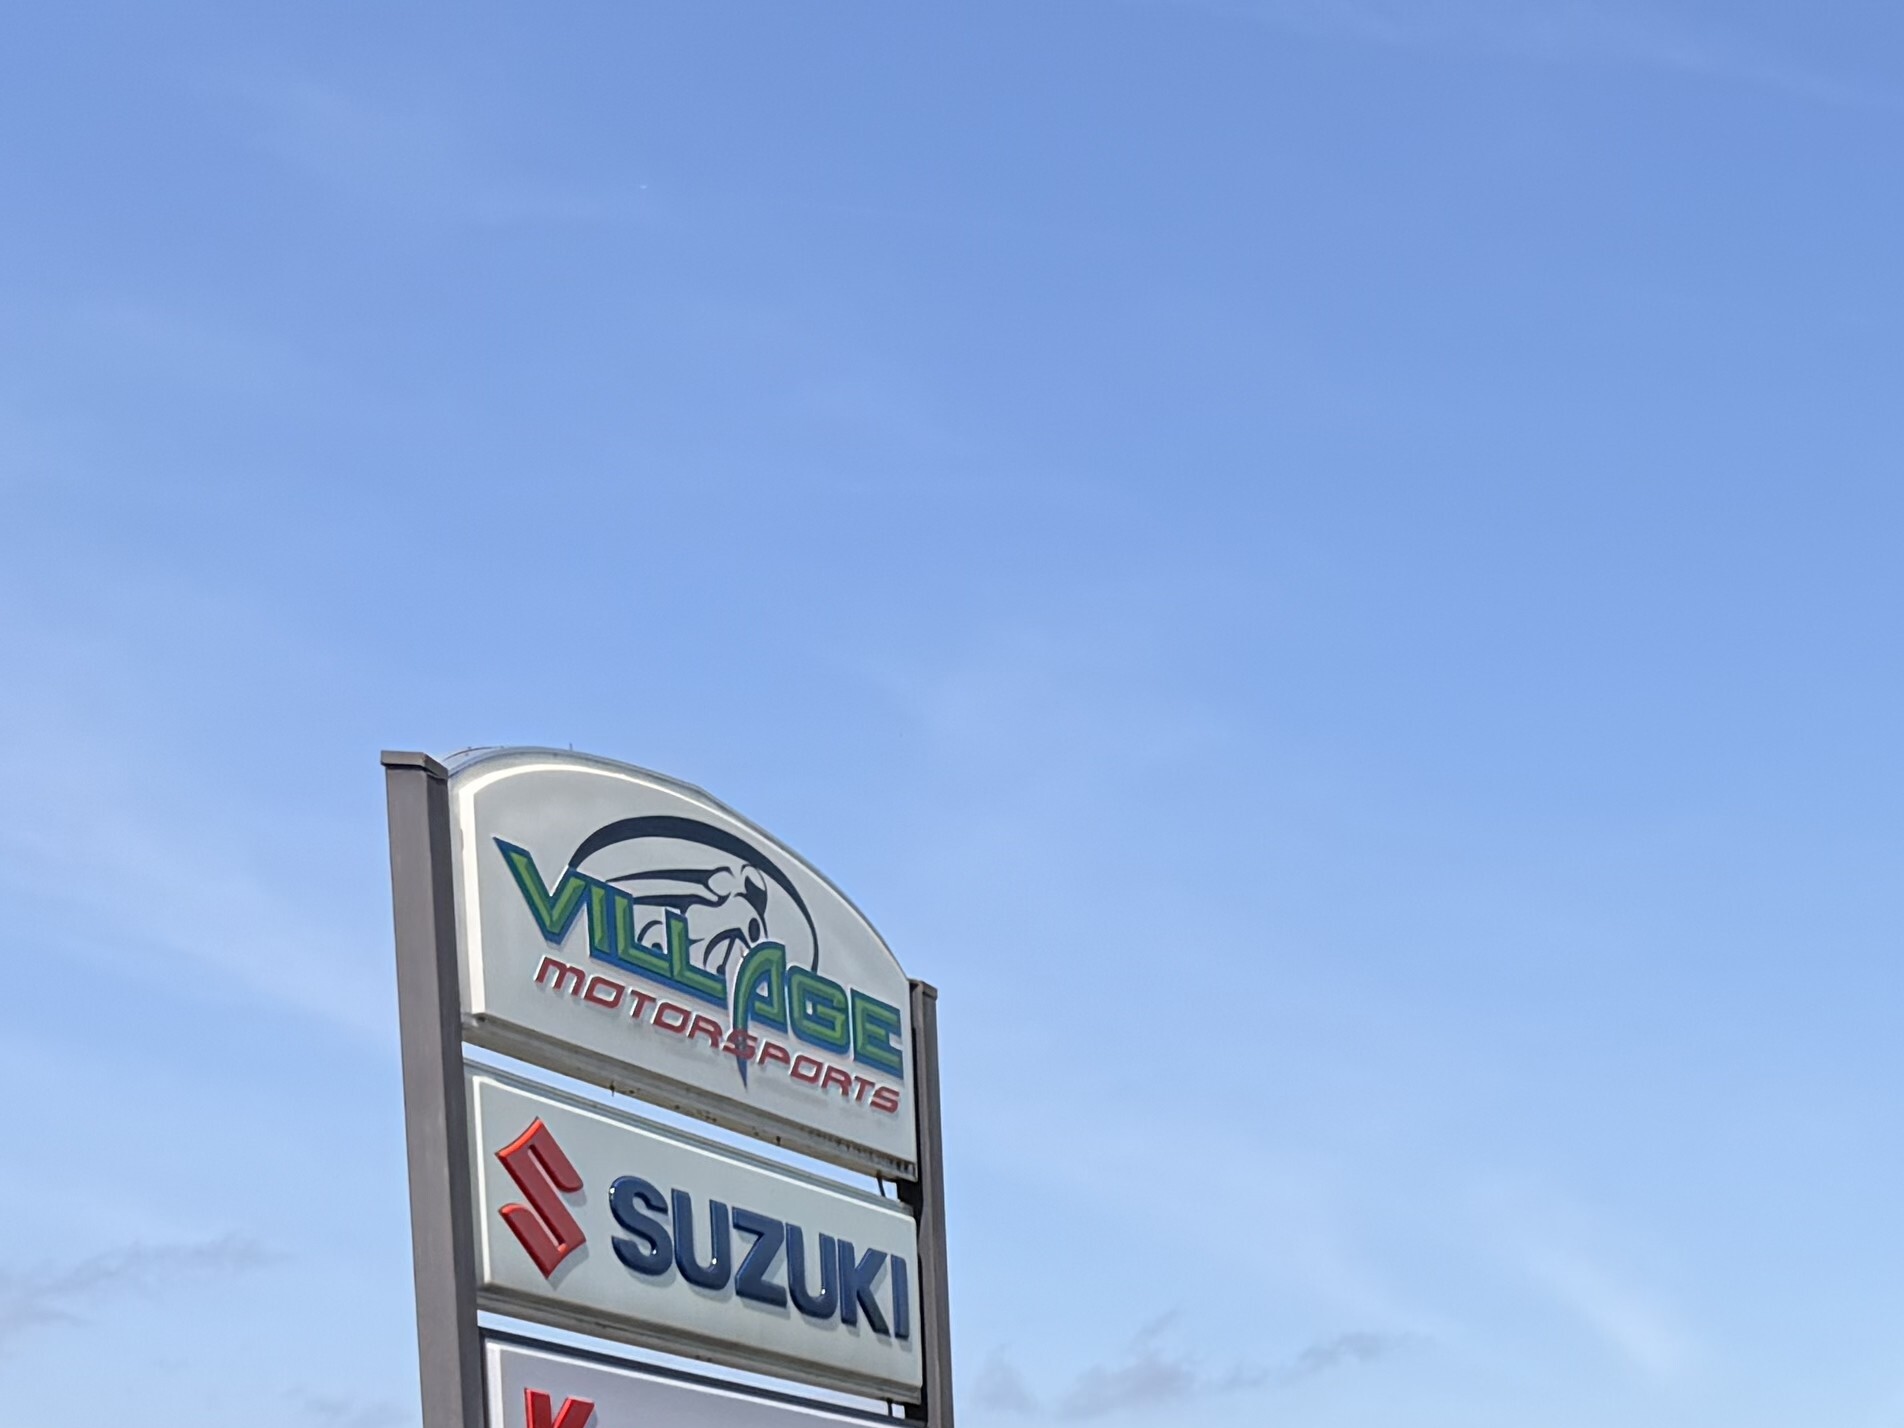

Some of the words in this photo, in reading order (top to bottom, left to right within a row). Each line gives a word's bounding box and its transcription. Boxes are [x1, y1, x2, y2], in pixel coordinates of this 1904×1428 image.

[493, 836, 904, 1090] VILLAGE
[534, 956, 901, 1114] MOTORSPORTS
[608, 1175, 911, 1341] SUZUKI
